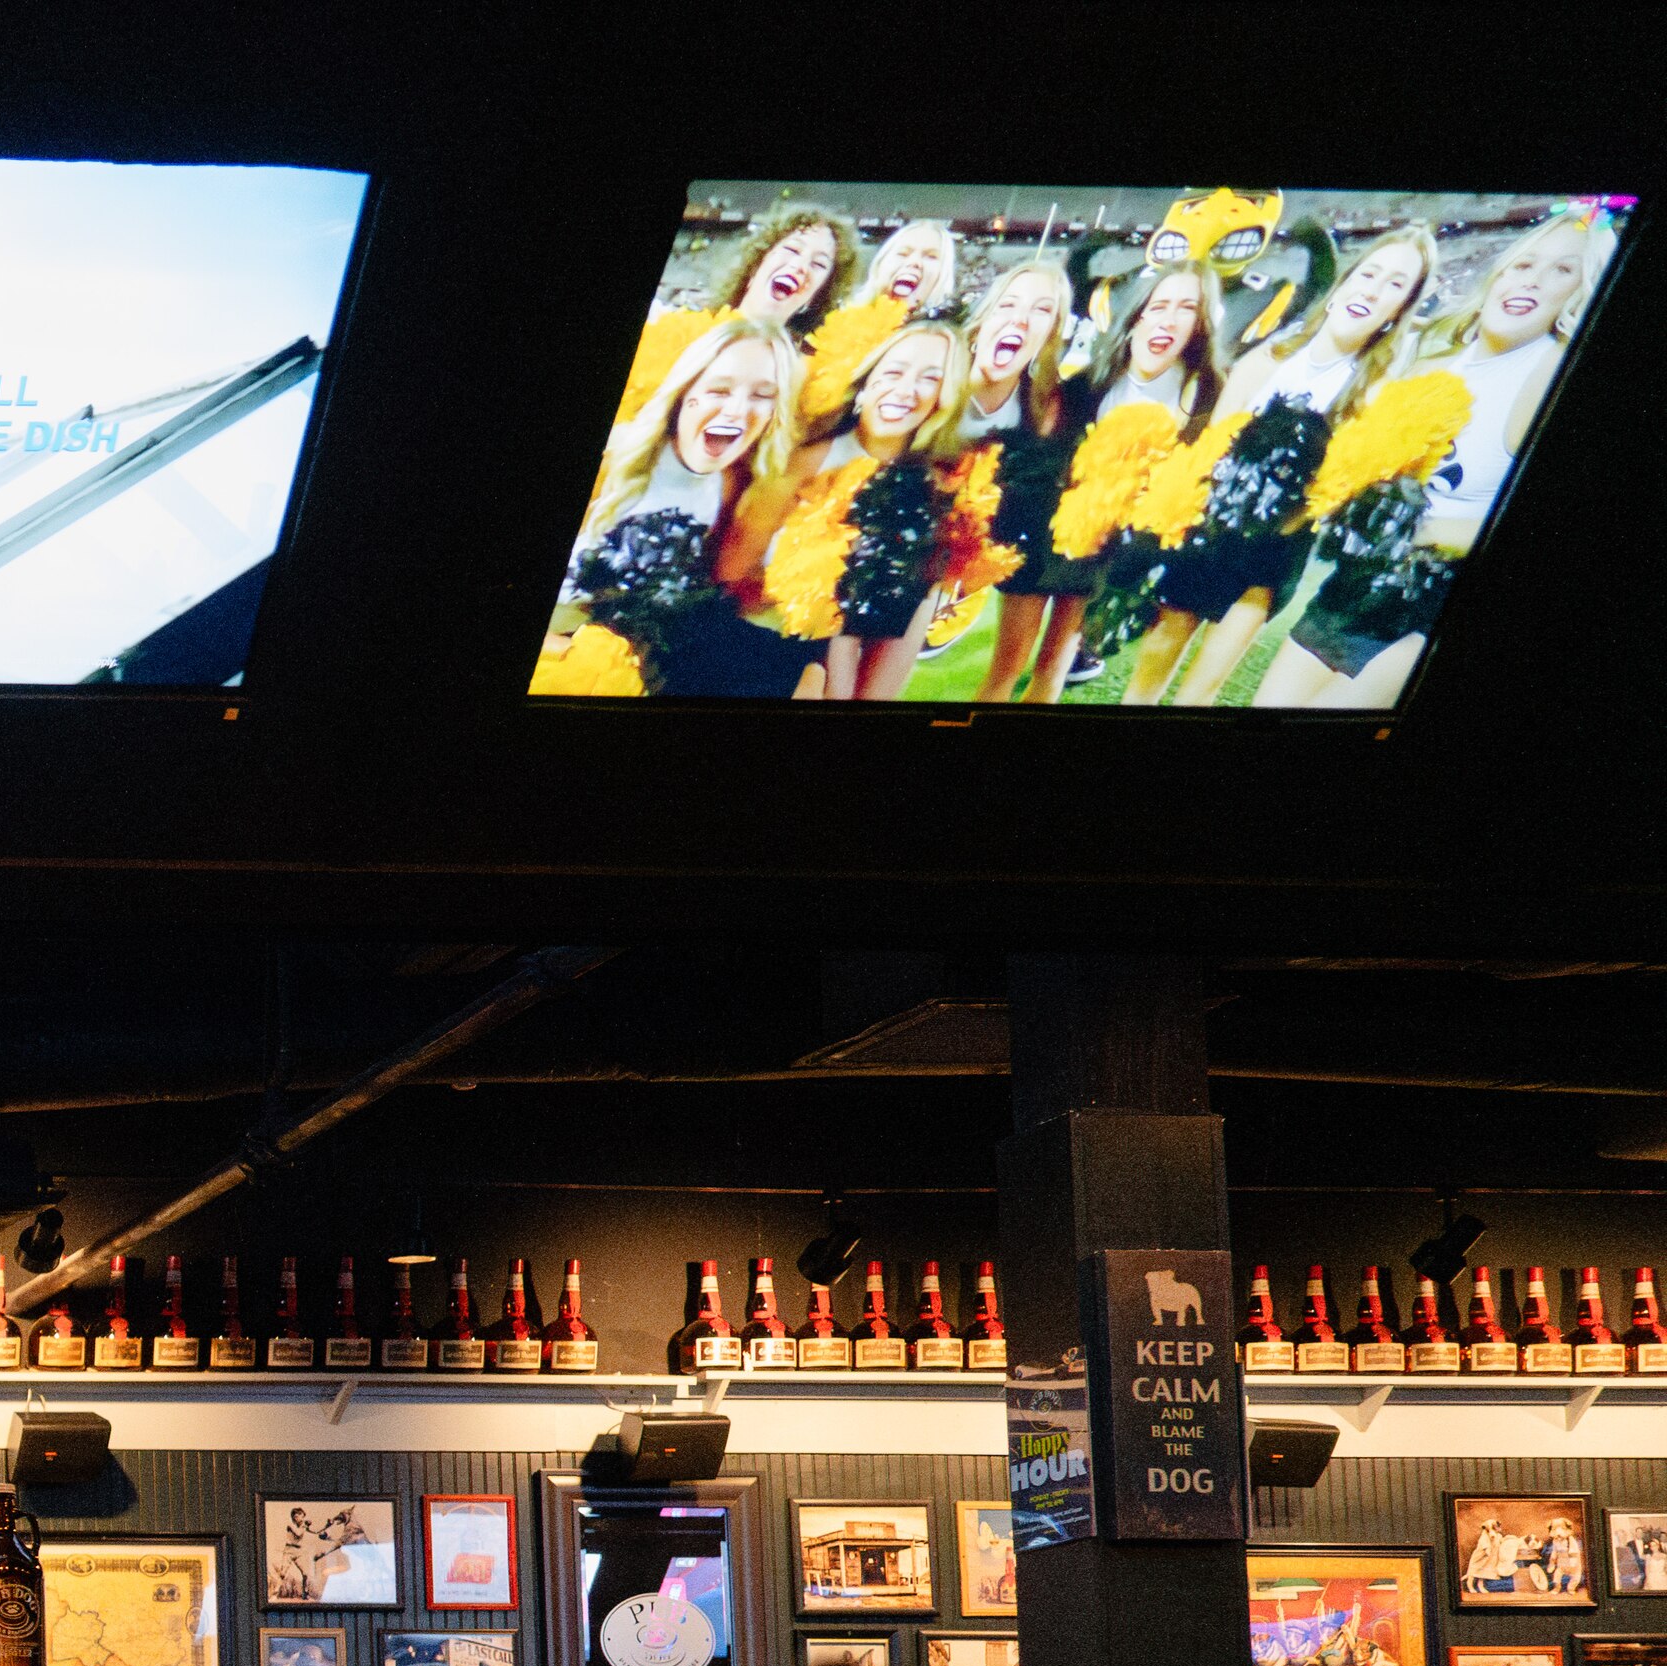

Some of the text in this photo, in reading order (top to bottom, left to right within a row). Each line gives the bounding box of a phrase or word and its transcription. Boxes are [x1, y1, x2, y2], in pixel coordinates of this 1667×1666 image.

[24, 421, 120, 452] DISH
[1136, 1341, 1215, 1366] KEEP
[1132, 1377, 1220, 1403] CALM
[1161, 1408, 1194, 1420] AND
[1151, 1426, 1205, 1438] BLAME
[1020, 1431, 1071, 1460] Happy
[1165, 1443, 1193, 1455] THE
[1011, 1450, 1088, 1492] HOUR
[1148, 1467, 1214, 1493] DOG
